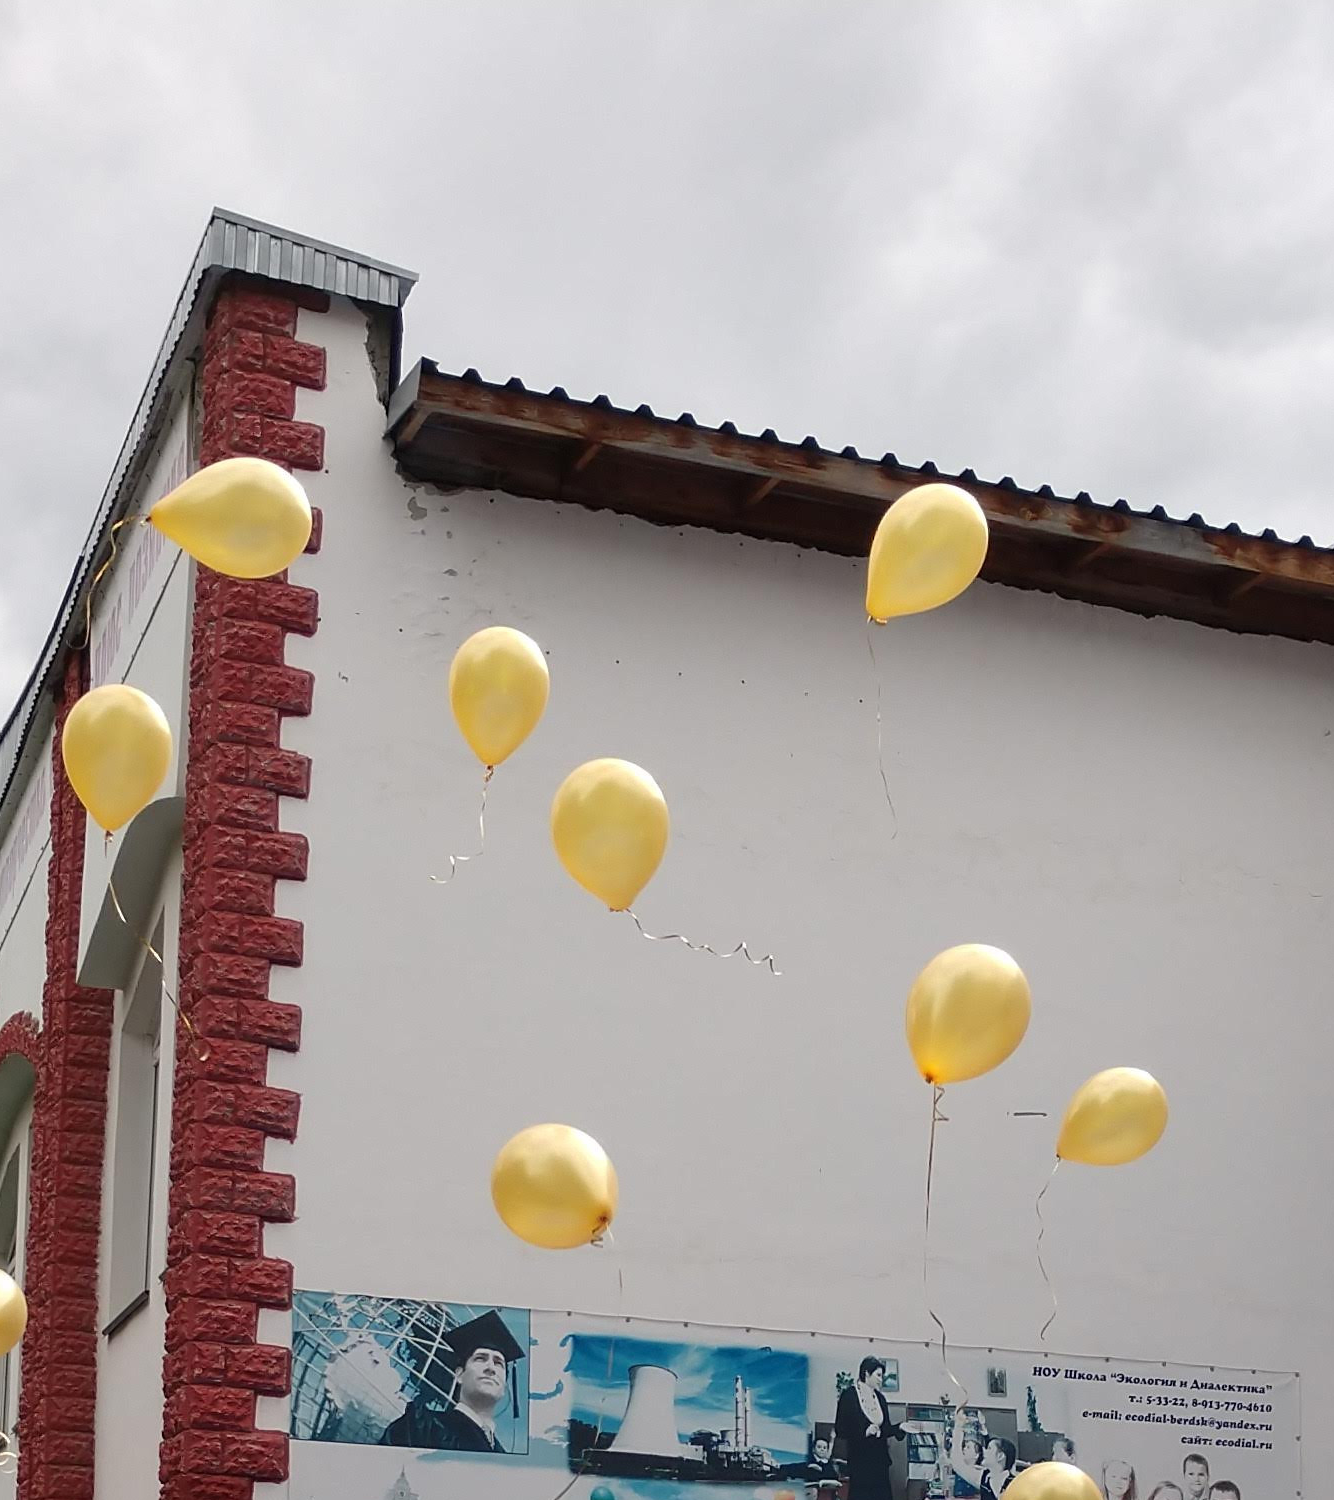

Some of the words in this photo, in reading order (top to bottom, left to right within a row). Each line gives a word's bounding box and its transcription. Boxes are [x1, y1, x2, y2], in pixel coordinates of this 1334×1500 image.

[1033, 1366, 1061, 1378] НОУ
[1064, 1369, 1107, 1382] Школа
[1179, 1380, 1187, 1388] и
[1128, 1394, 1143, 1403] т.:
[1146, 1395, 1188, 1408] 5-33-22,
[1191, 1397, 1273, 1413] 8-913-770-4610
[1082, 1409, 1122, 1421] e-mail:
[1125, 1412, 1273, 1432] ecodial-berdsk@yandex.ru
[1181, 1434, 1213, 1446] сайт:
[1215, 1436, 1273, 1450] ecodial.ru
